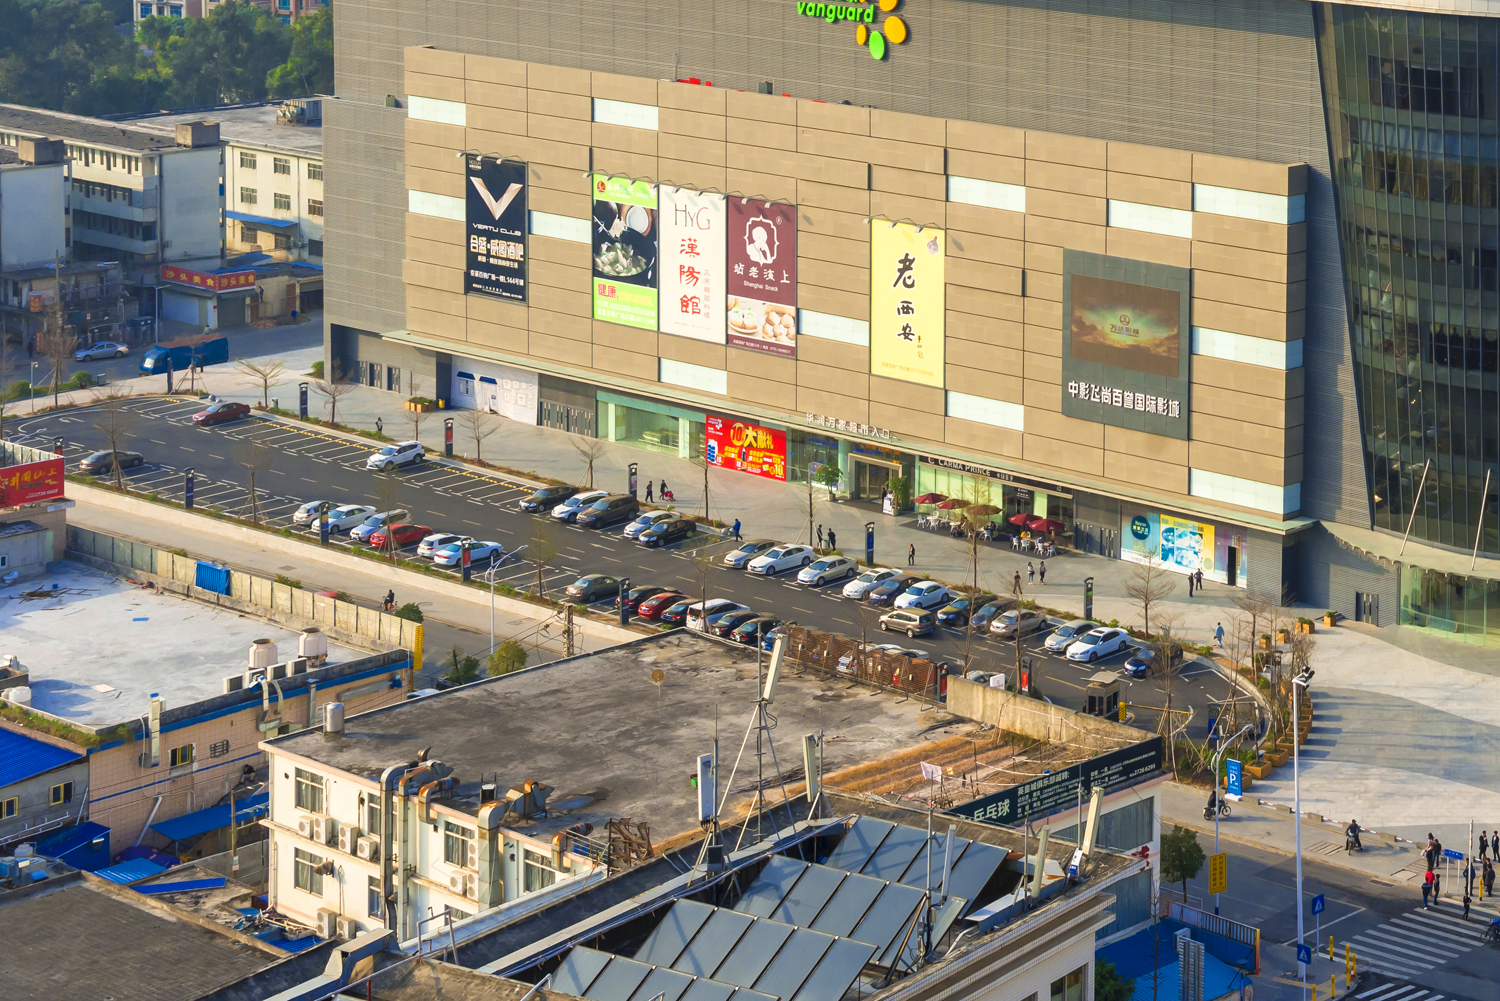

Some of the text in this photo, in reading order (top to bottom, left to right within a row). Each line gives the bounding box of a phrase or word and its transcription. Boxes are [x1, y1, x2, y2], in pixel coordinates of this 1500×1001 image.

[797, 1, 875, 23] vanguard
[166, 270, 215, 287] 沙头美食
[221, 274, 255, 287] 沙头美食
[679, 237, 702, 316] 漢陽館
[743, 280, 778, 292] Shanghai Snack
[892, 252, 917, 342] 老西安
[938, 459, 963, 471] CARMA
[965, 465, 990, 477] PRINCE
[1229, 773, 1237, 785] P
[974, 799, 1010, 822] 乒乓球
